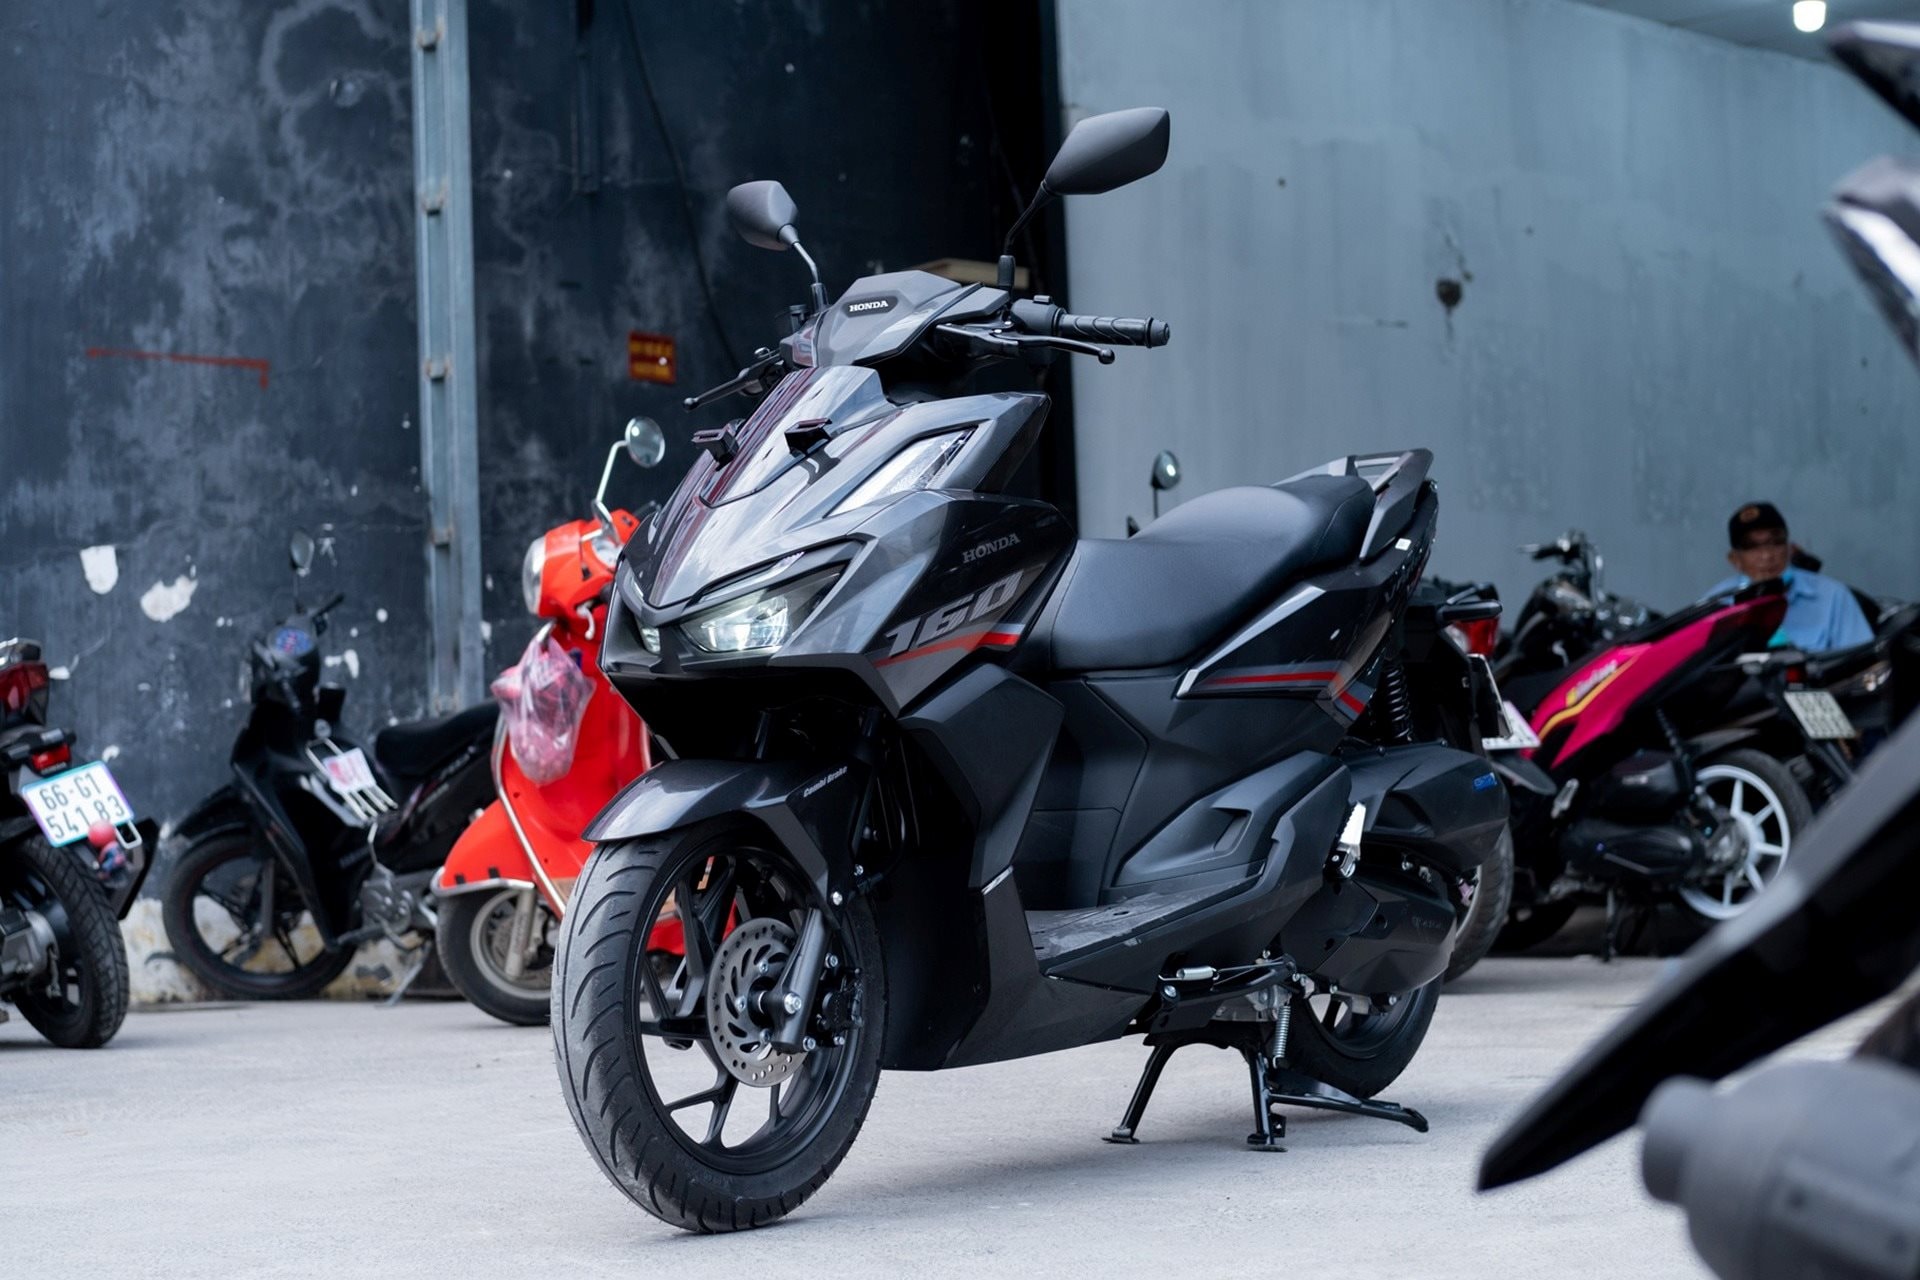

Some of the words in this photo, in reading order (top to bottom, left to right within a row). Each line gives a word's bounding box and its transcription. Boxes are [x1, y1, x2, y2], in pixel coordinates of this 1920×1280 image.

[849, 300, 889, 312] HONDA
[962, 532, 1022, 564] HONDA
[884, 569, 1024, 657] 160
